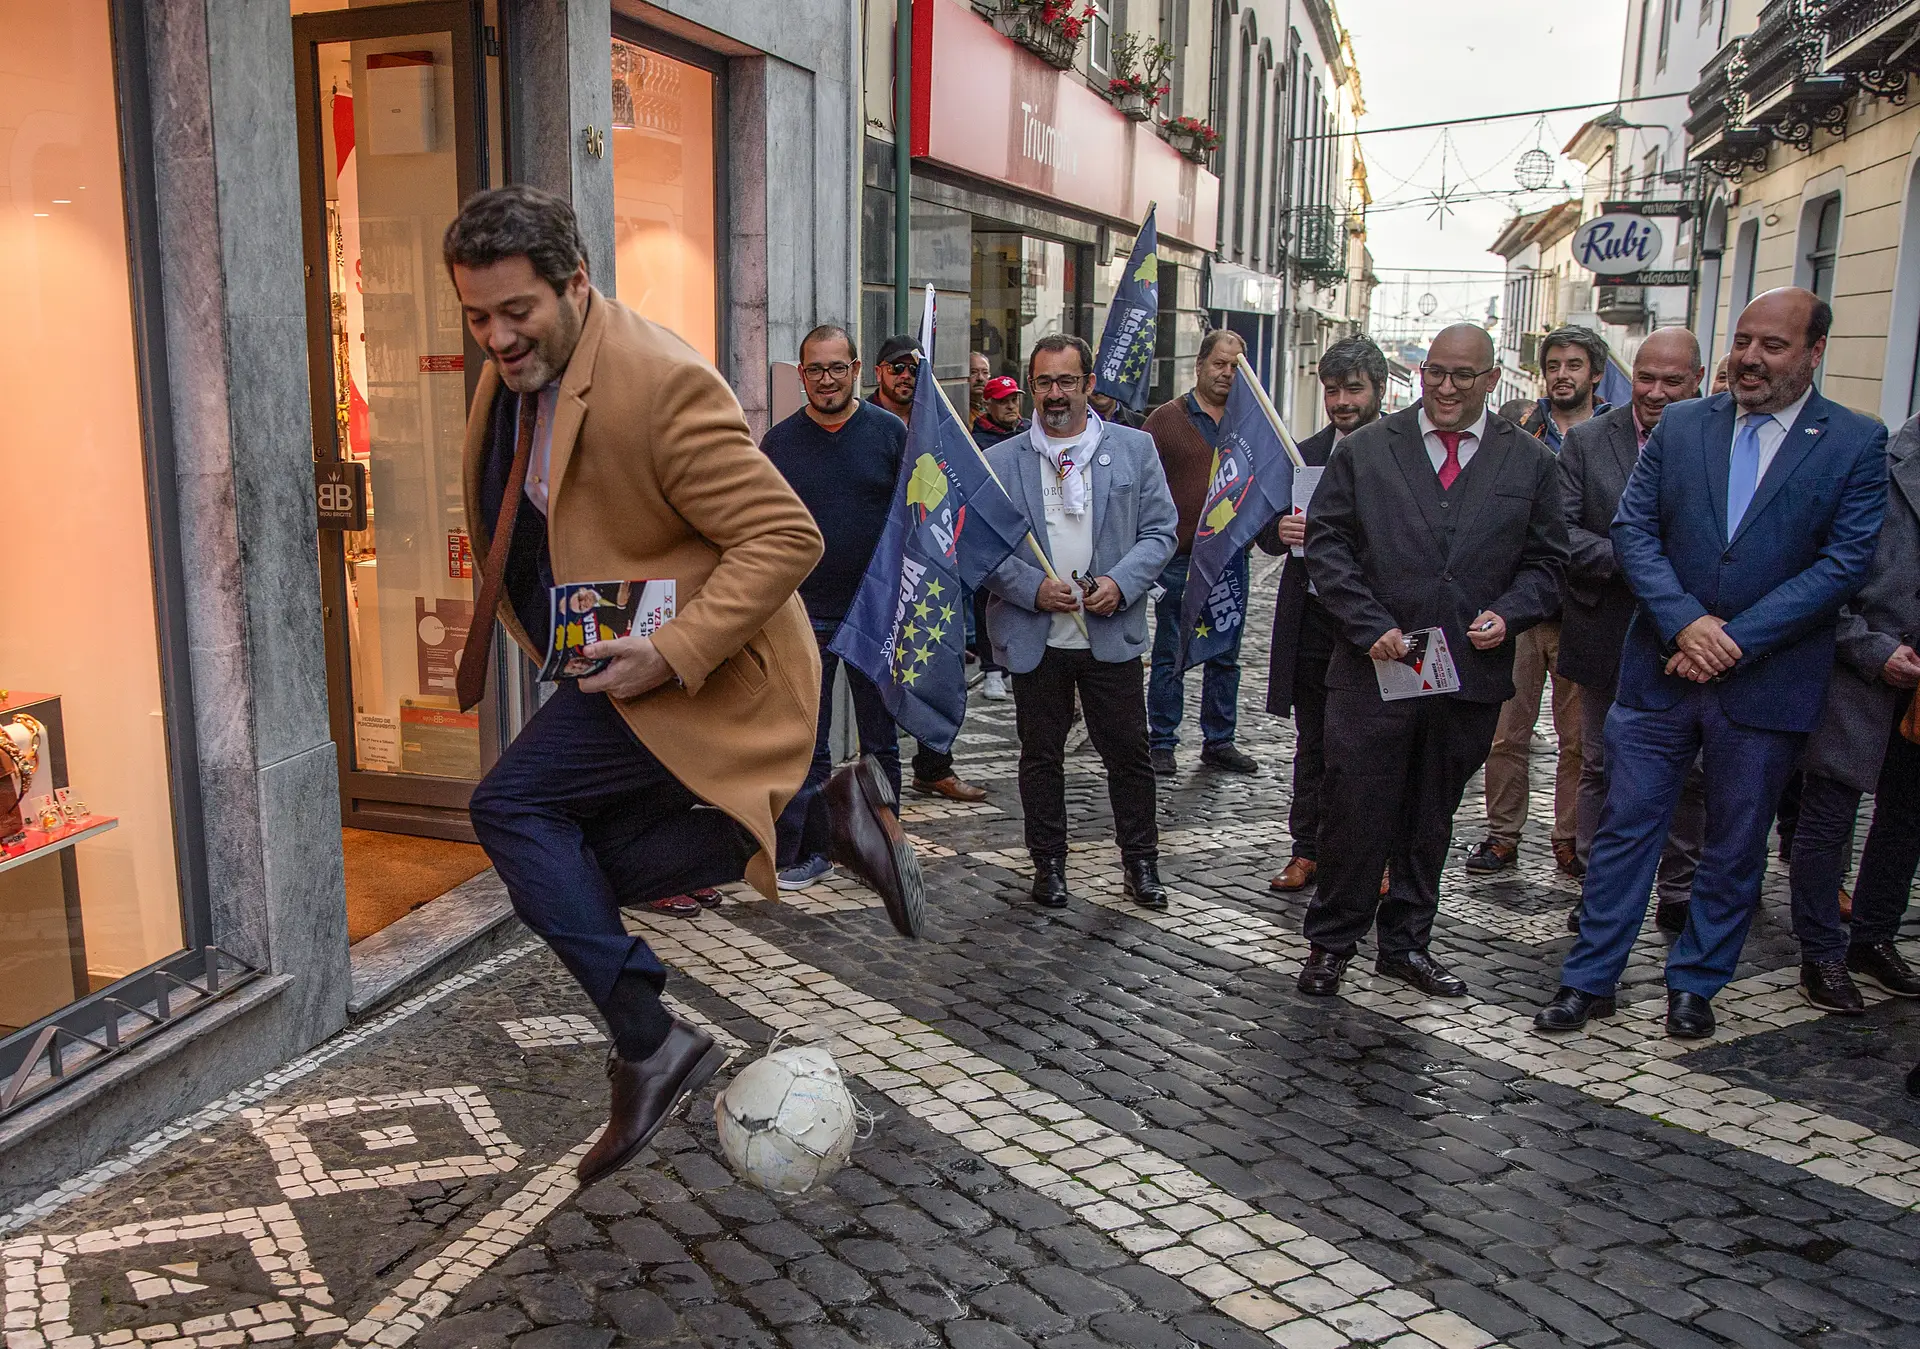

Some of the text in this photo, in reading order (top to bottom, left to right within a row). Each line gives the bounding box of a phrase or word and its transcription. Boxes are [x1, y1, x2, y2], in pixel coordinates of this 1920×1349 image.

[586, 124, 604, 159] 36
[1580, 221, 1651, 264] Rubi
[1208, 580, 1241, 632] RES
[1228, 577, 1241, 598] TUA
